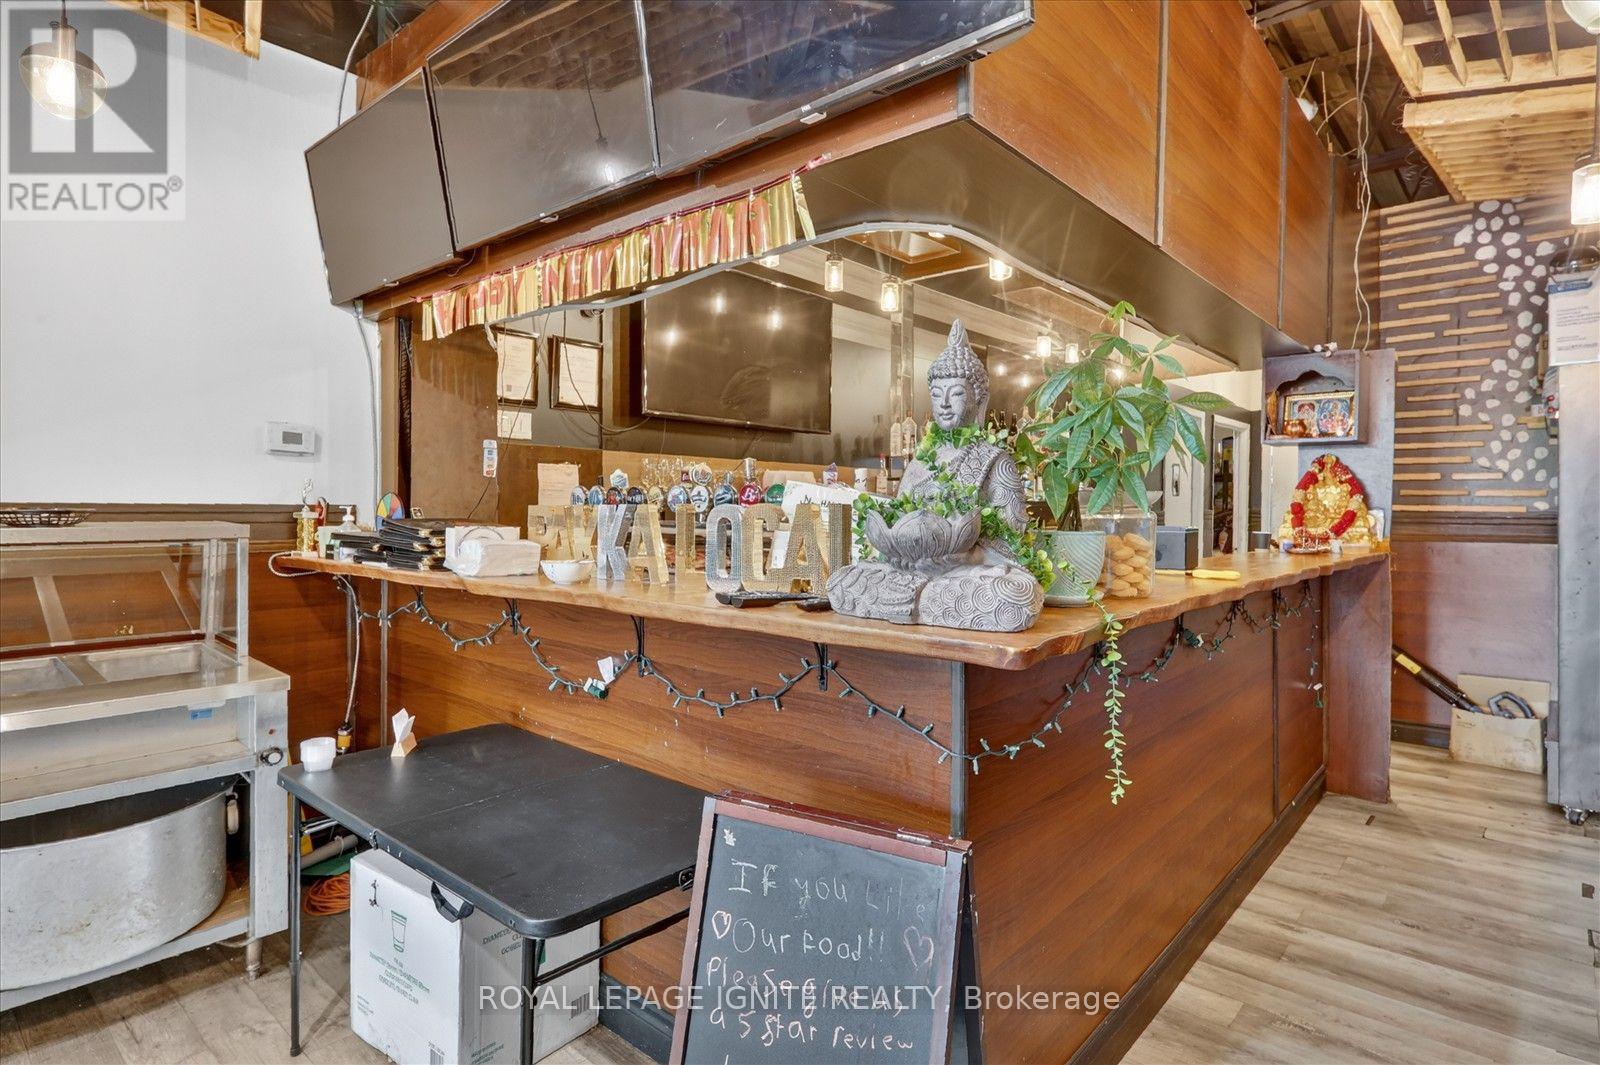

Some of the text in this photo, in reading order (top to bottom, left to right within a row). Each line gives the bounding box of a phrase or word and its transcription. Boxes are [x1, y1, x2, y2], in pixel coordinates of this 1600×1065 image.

[794, 876, 848, 906] you
[732, 918, 791, 953] Our
[738, 1010, 756, 1039] 5
[832, 1024, 914, 1050] review
